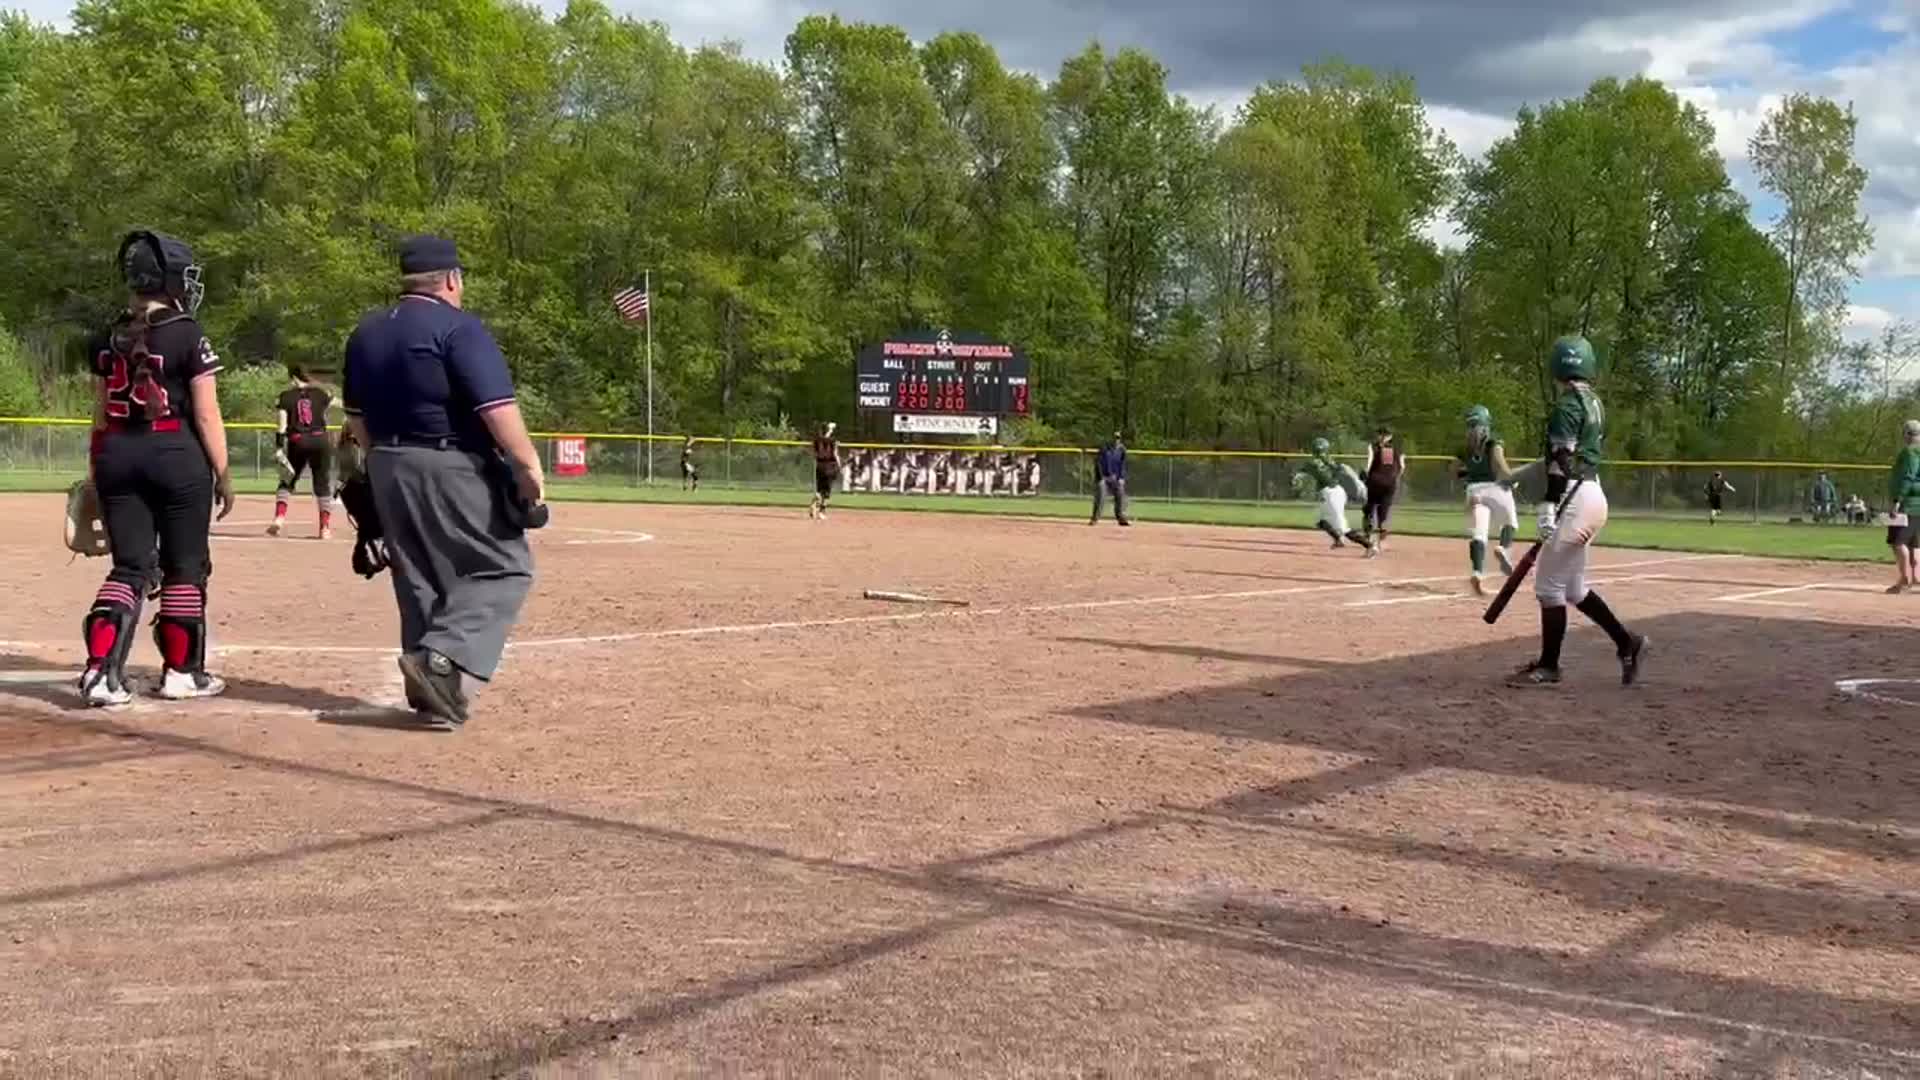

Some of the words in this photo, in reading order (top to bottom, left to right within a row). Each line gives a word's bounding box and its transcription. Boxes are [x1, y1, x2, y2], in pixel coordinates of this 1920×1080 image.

[883, 359, 904, 370] BALL
[974, 361, 993, 372] OUT
[860, 383, 890, 394] GUEST
[555, 437, 585, 464] 195
